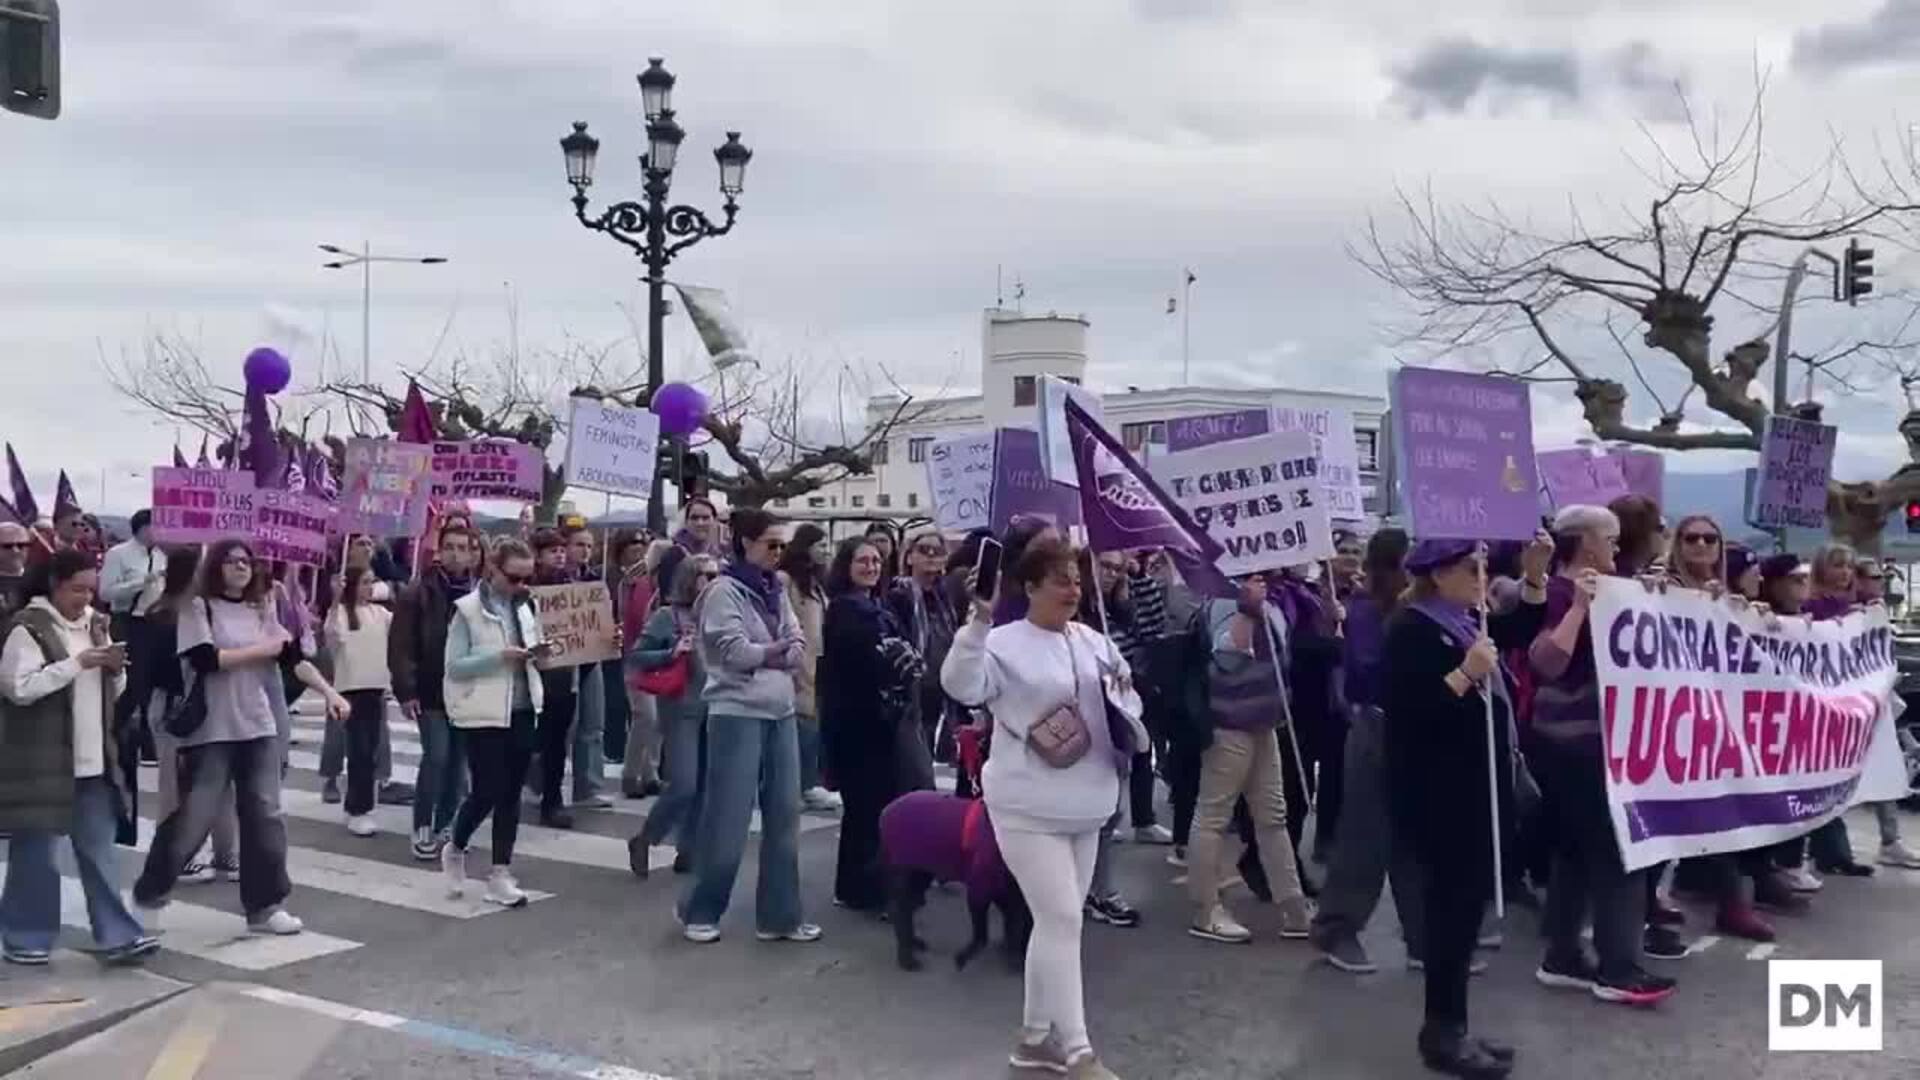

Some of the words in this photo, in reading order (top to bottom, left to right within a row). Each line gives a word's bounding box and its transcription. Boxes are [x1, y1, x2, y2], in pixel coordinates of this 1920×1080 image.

[601, 408, 636, 428] SOMOS
[586, 425, 650, 453] FEMINISTAS
[611, 453, 619, 466] Y
[1609, 608, 1720, 672] CONTRA
[1725, 622, 1763, 675] EL
[1604, 685, 1743, 785] LUCHA
